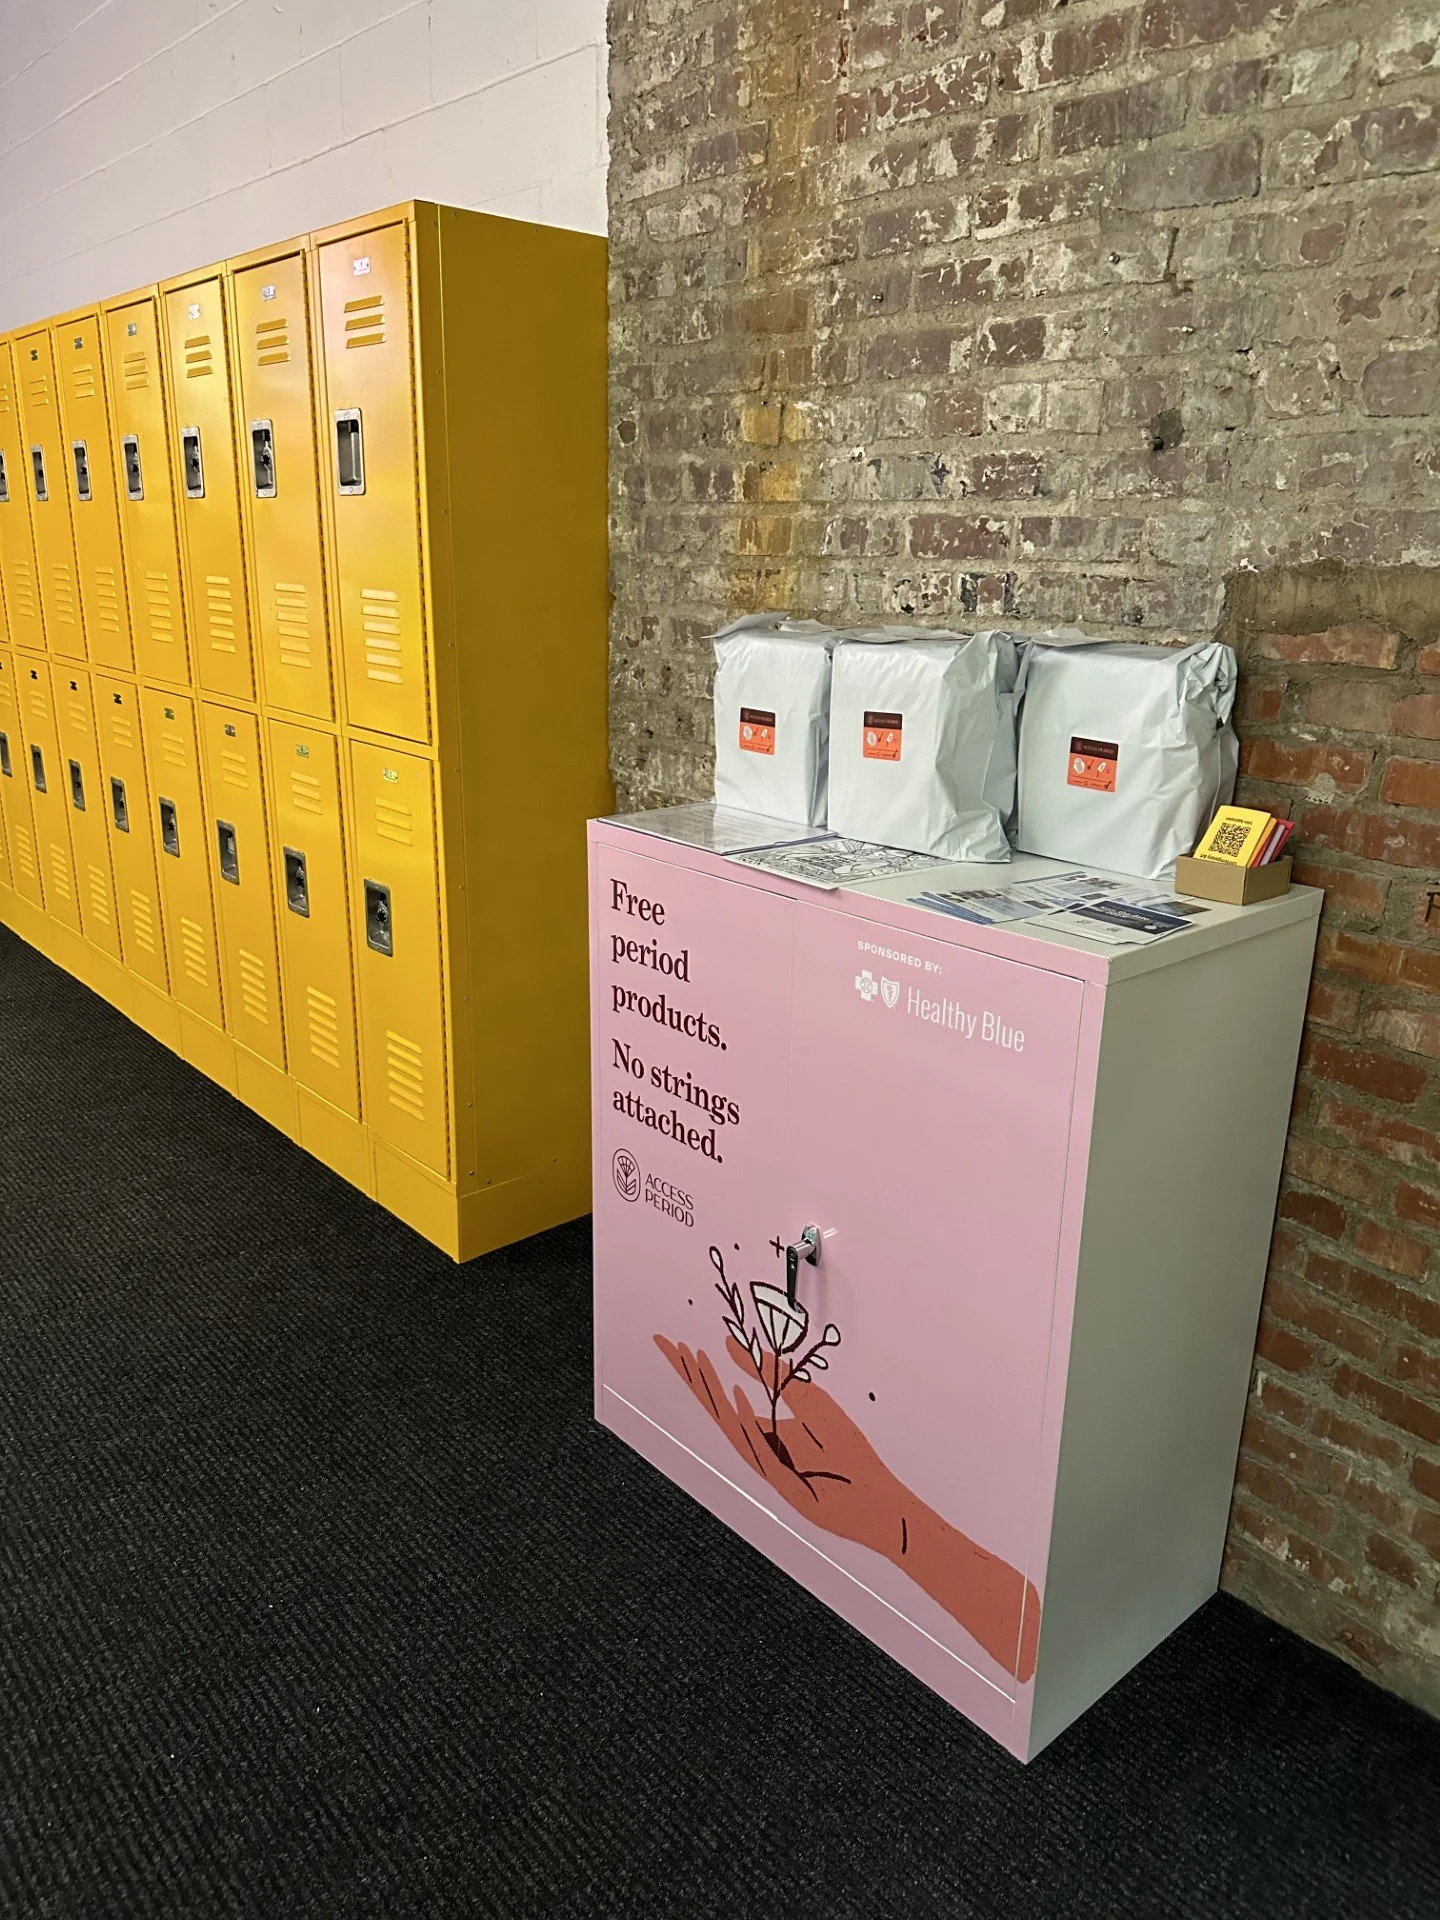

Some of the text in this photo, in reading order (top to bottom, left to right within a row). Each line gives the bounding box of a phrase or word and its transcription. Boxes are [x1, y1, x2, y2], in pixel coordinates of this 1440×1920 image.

[610, 879, 665, 926] Free
[611, 935, 690, 983] period
[857, 940, 942, 974] SPONSORED BY:
[612, 985, 727, 1050] products.
[907, 986, 1025, 1052] Healthy Blue
[612, 1038, 739, 1125] No strings
[613, 1091, 722, 1163] attached.
[645, 1174, 694, 1210] ACCESS
[645, 1188, 694, 1227] PERIOD
